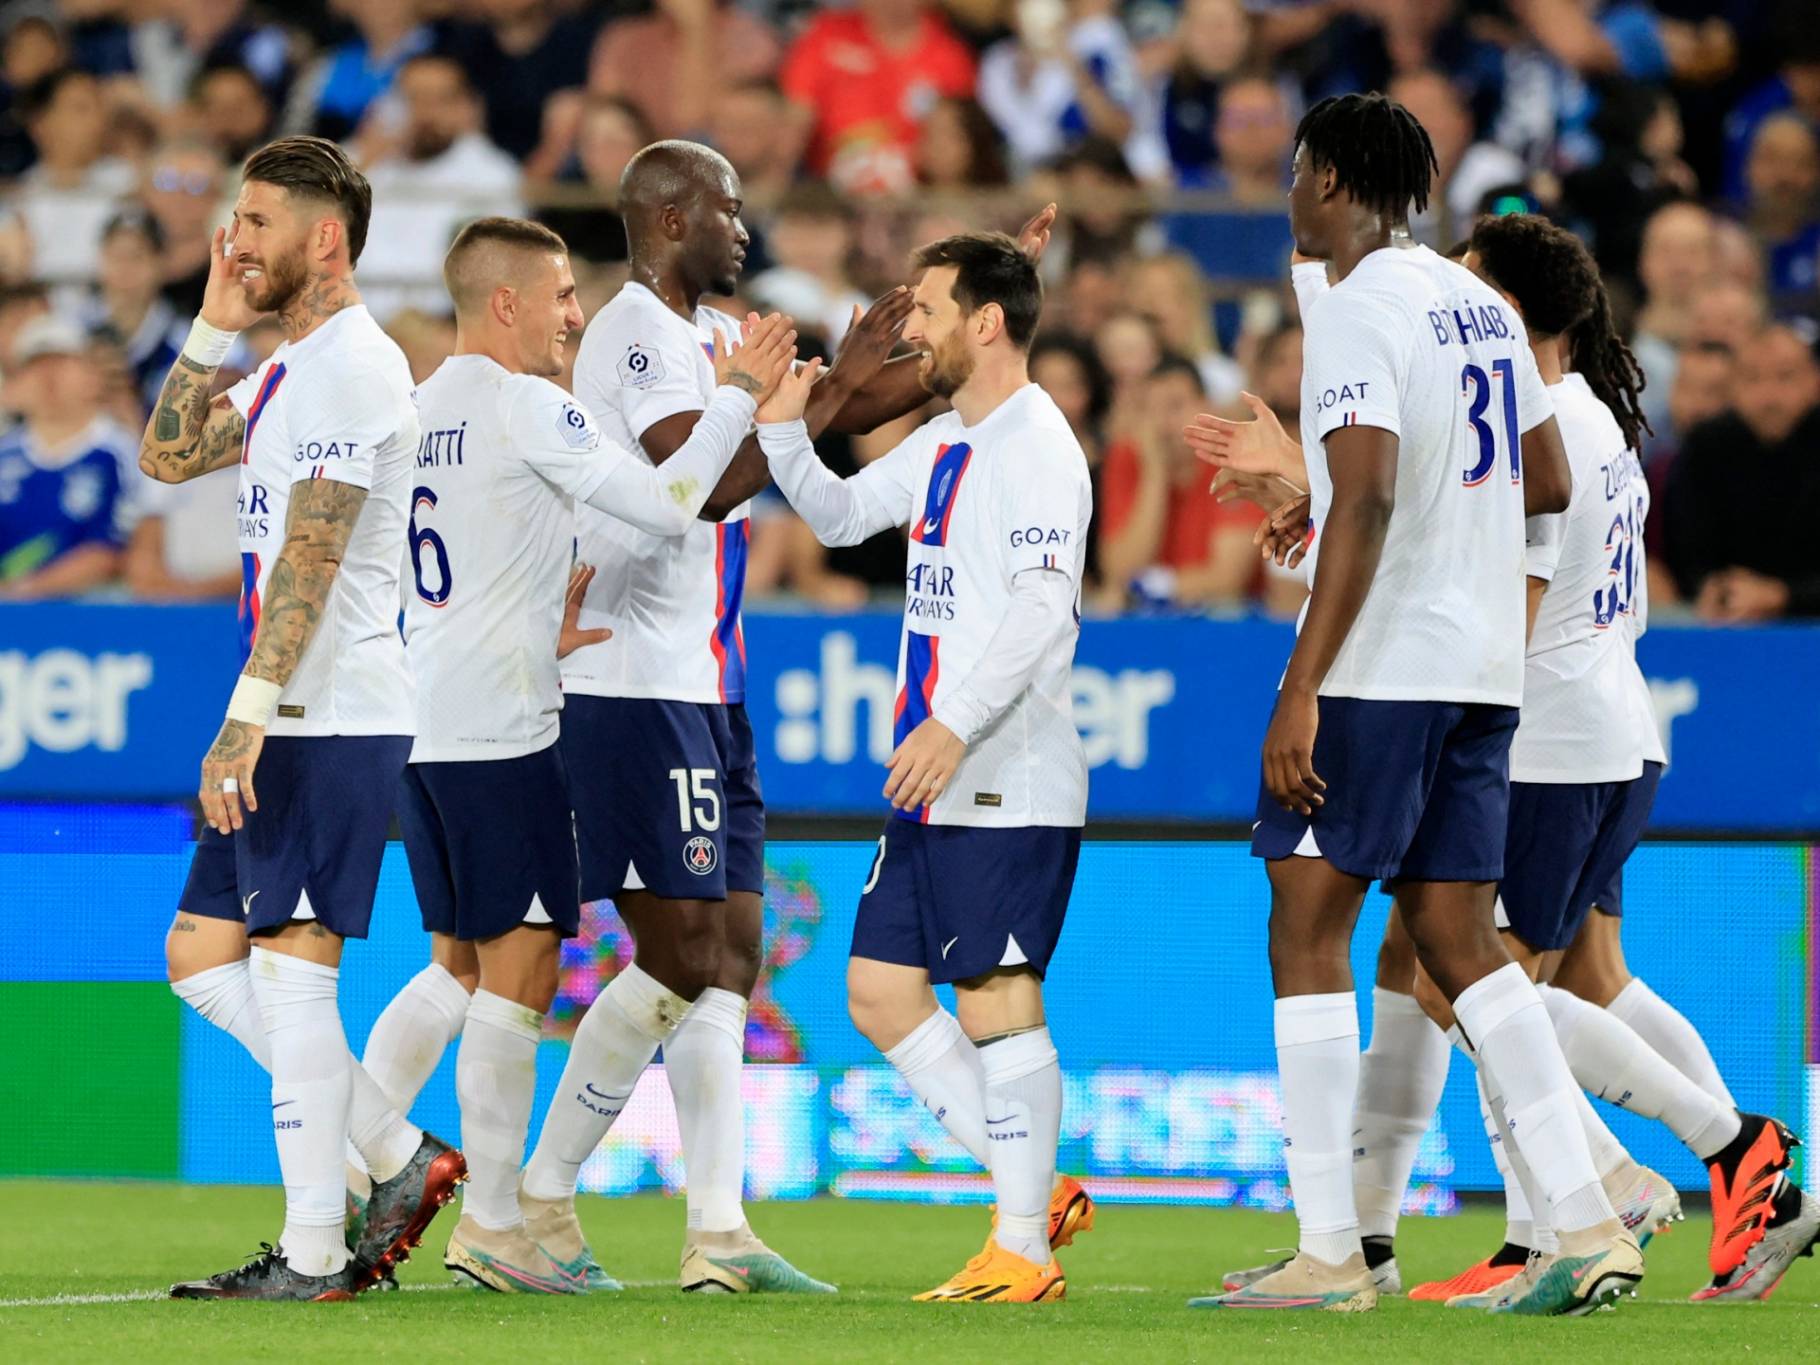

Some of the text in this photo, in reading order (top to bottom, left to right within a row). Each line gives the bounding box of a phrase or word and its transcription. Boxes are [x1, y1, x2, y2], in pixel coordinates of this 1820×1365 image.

[1461, 358, 1520, 488] 31
[294, 442, 358, 462] GOAT
[408, 486, 453, 608] 6
[1010, 527, 1071, 548] GOAT
[669, 768, 720, 832] 15
[274, 1119, 303, 1130] RIS
